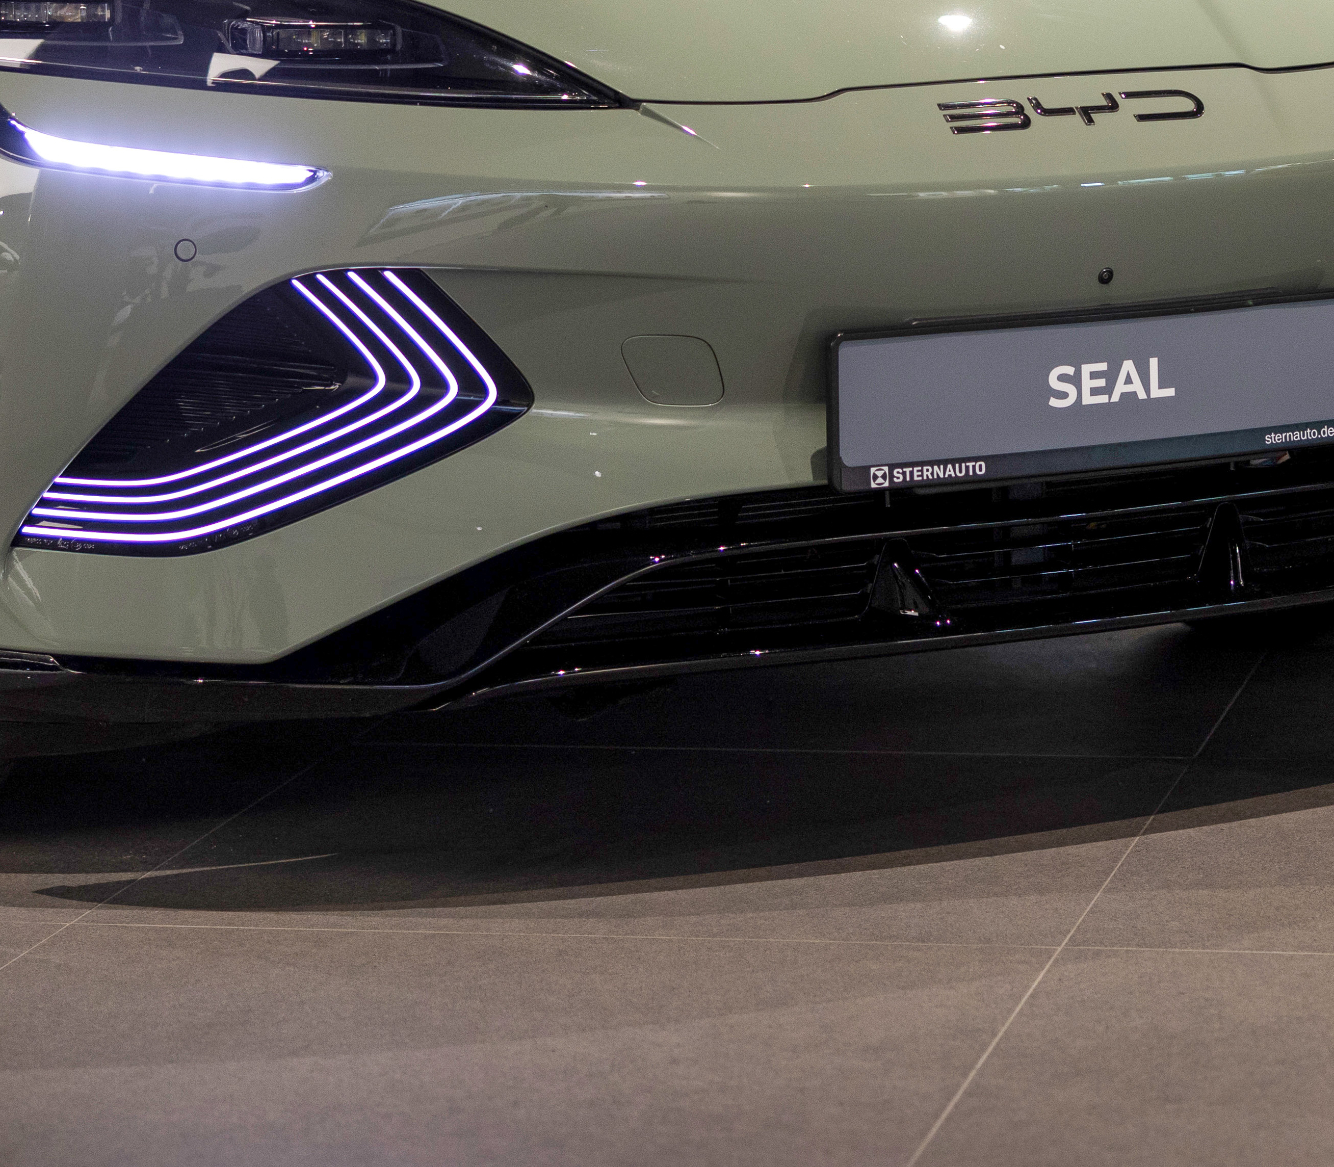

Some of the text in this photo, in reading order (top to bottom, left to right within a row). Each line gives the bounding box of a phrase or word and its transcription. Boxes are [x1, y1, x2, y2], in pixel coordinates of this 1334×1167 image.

[937, 89, 1205, 135] BYD
[1048, 357, 1175, 408] SEAL
[1264, 425, 1334, 445] sternauto.de
[893, 461, 986, 483] STERNAUTO
